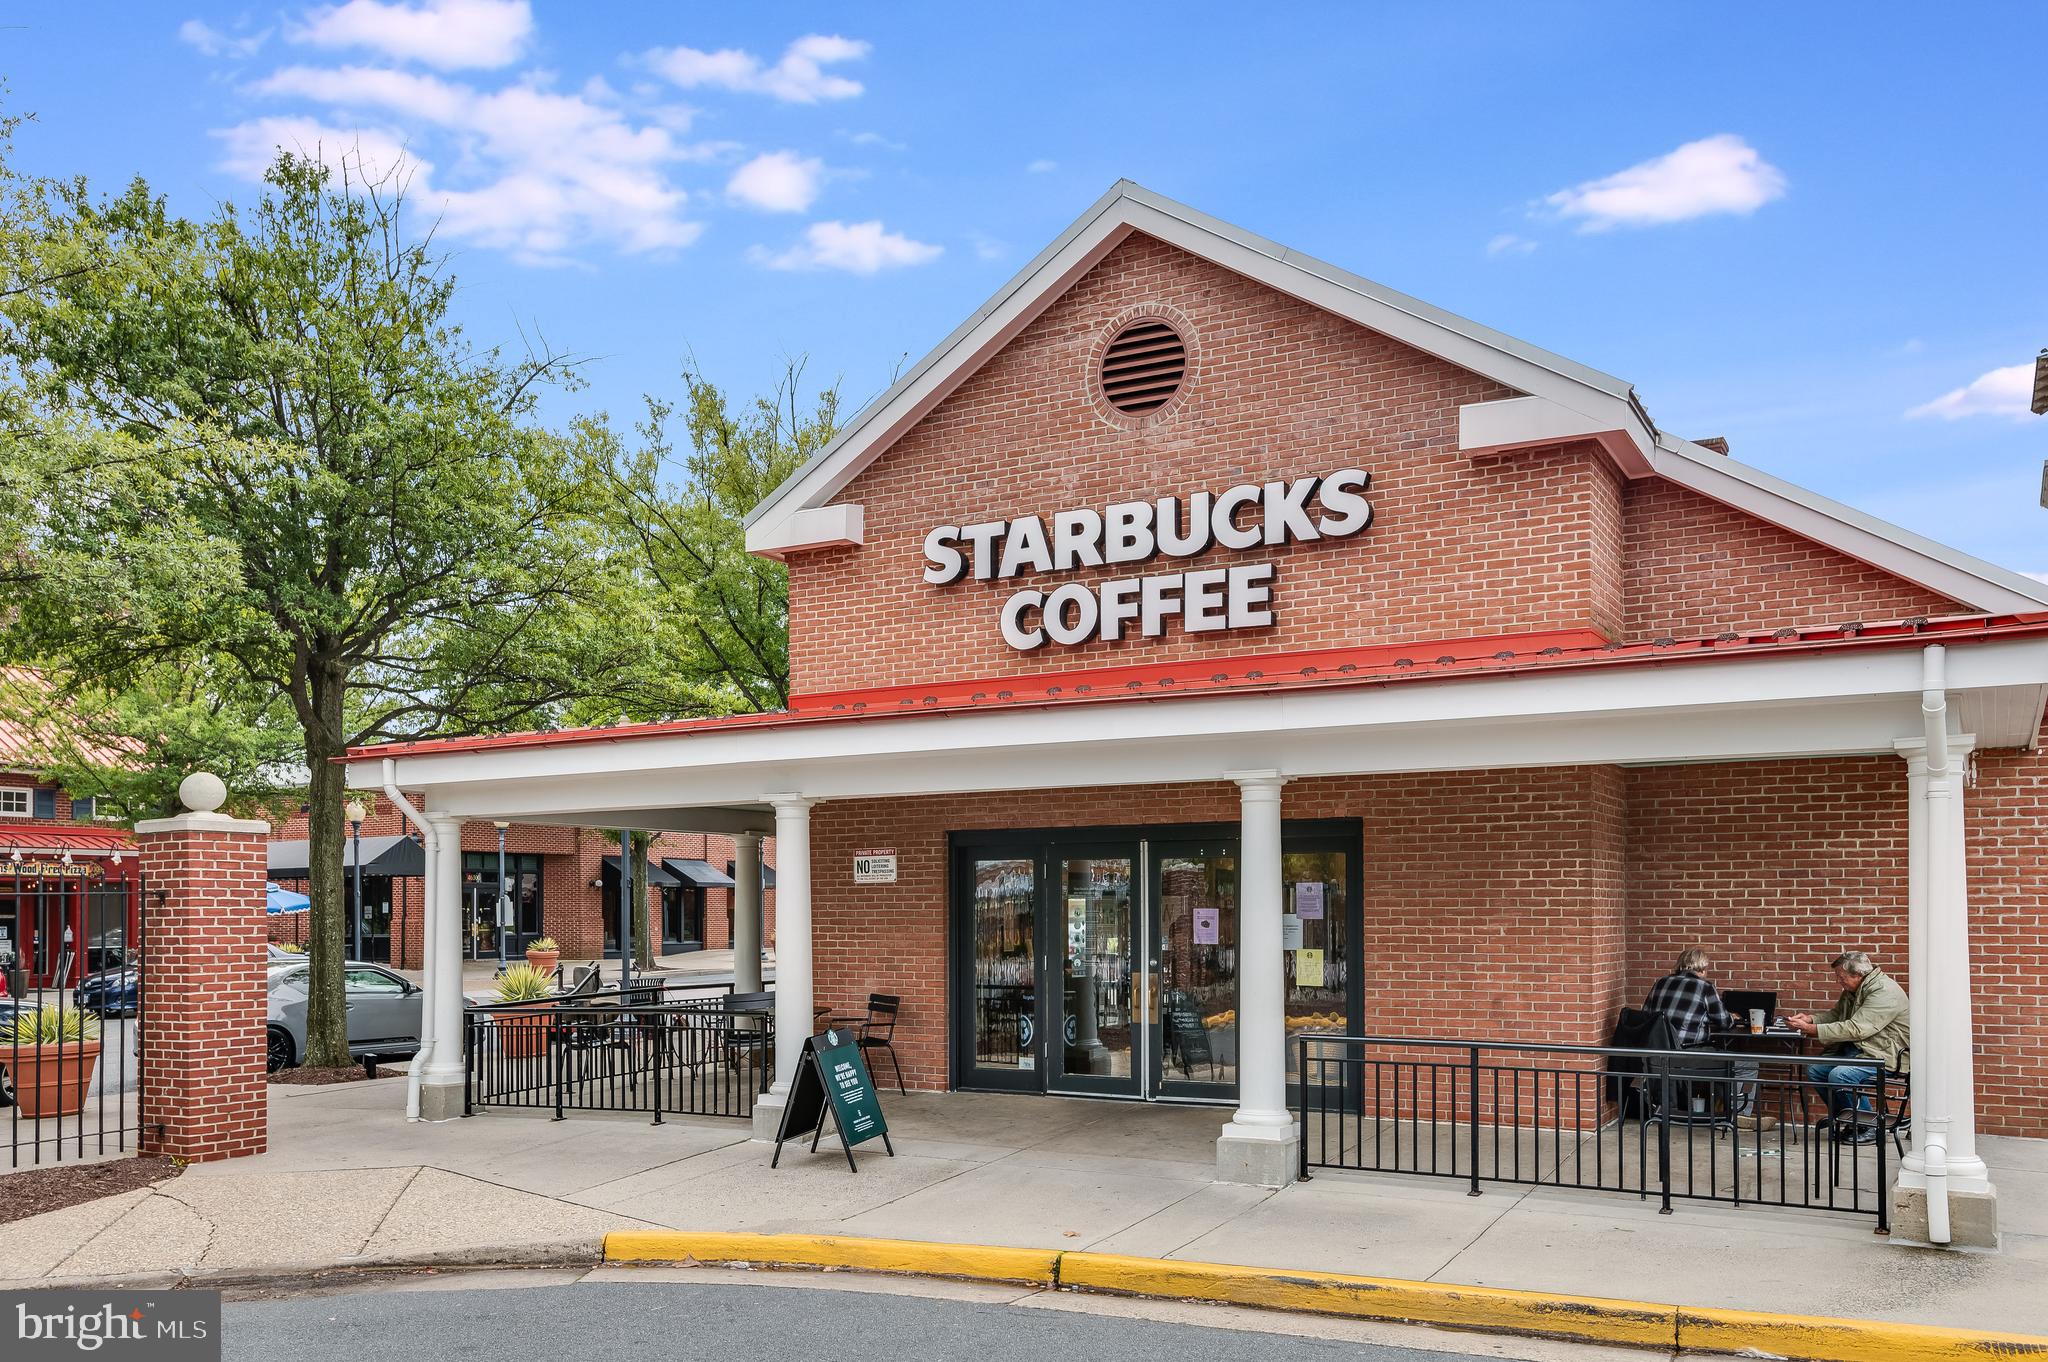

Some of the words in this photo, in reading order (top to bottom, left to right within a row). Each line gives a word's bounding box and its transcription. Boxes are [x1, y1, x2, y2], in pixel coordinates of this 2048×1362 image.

[923, 468, 1373, 585] STARBUCKS
[999, 563, 1276, 651] COFFEE
[13, 862, 37, 873] Wood
[65, 864, 86, 874] Pizza
[857, 860, 870, 874] NO
